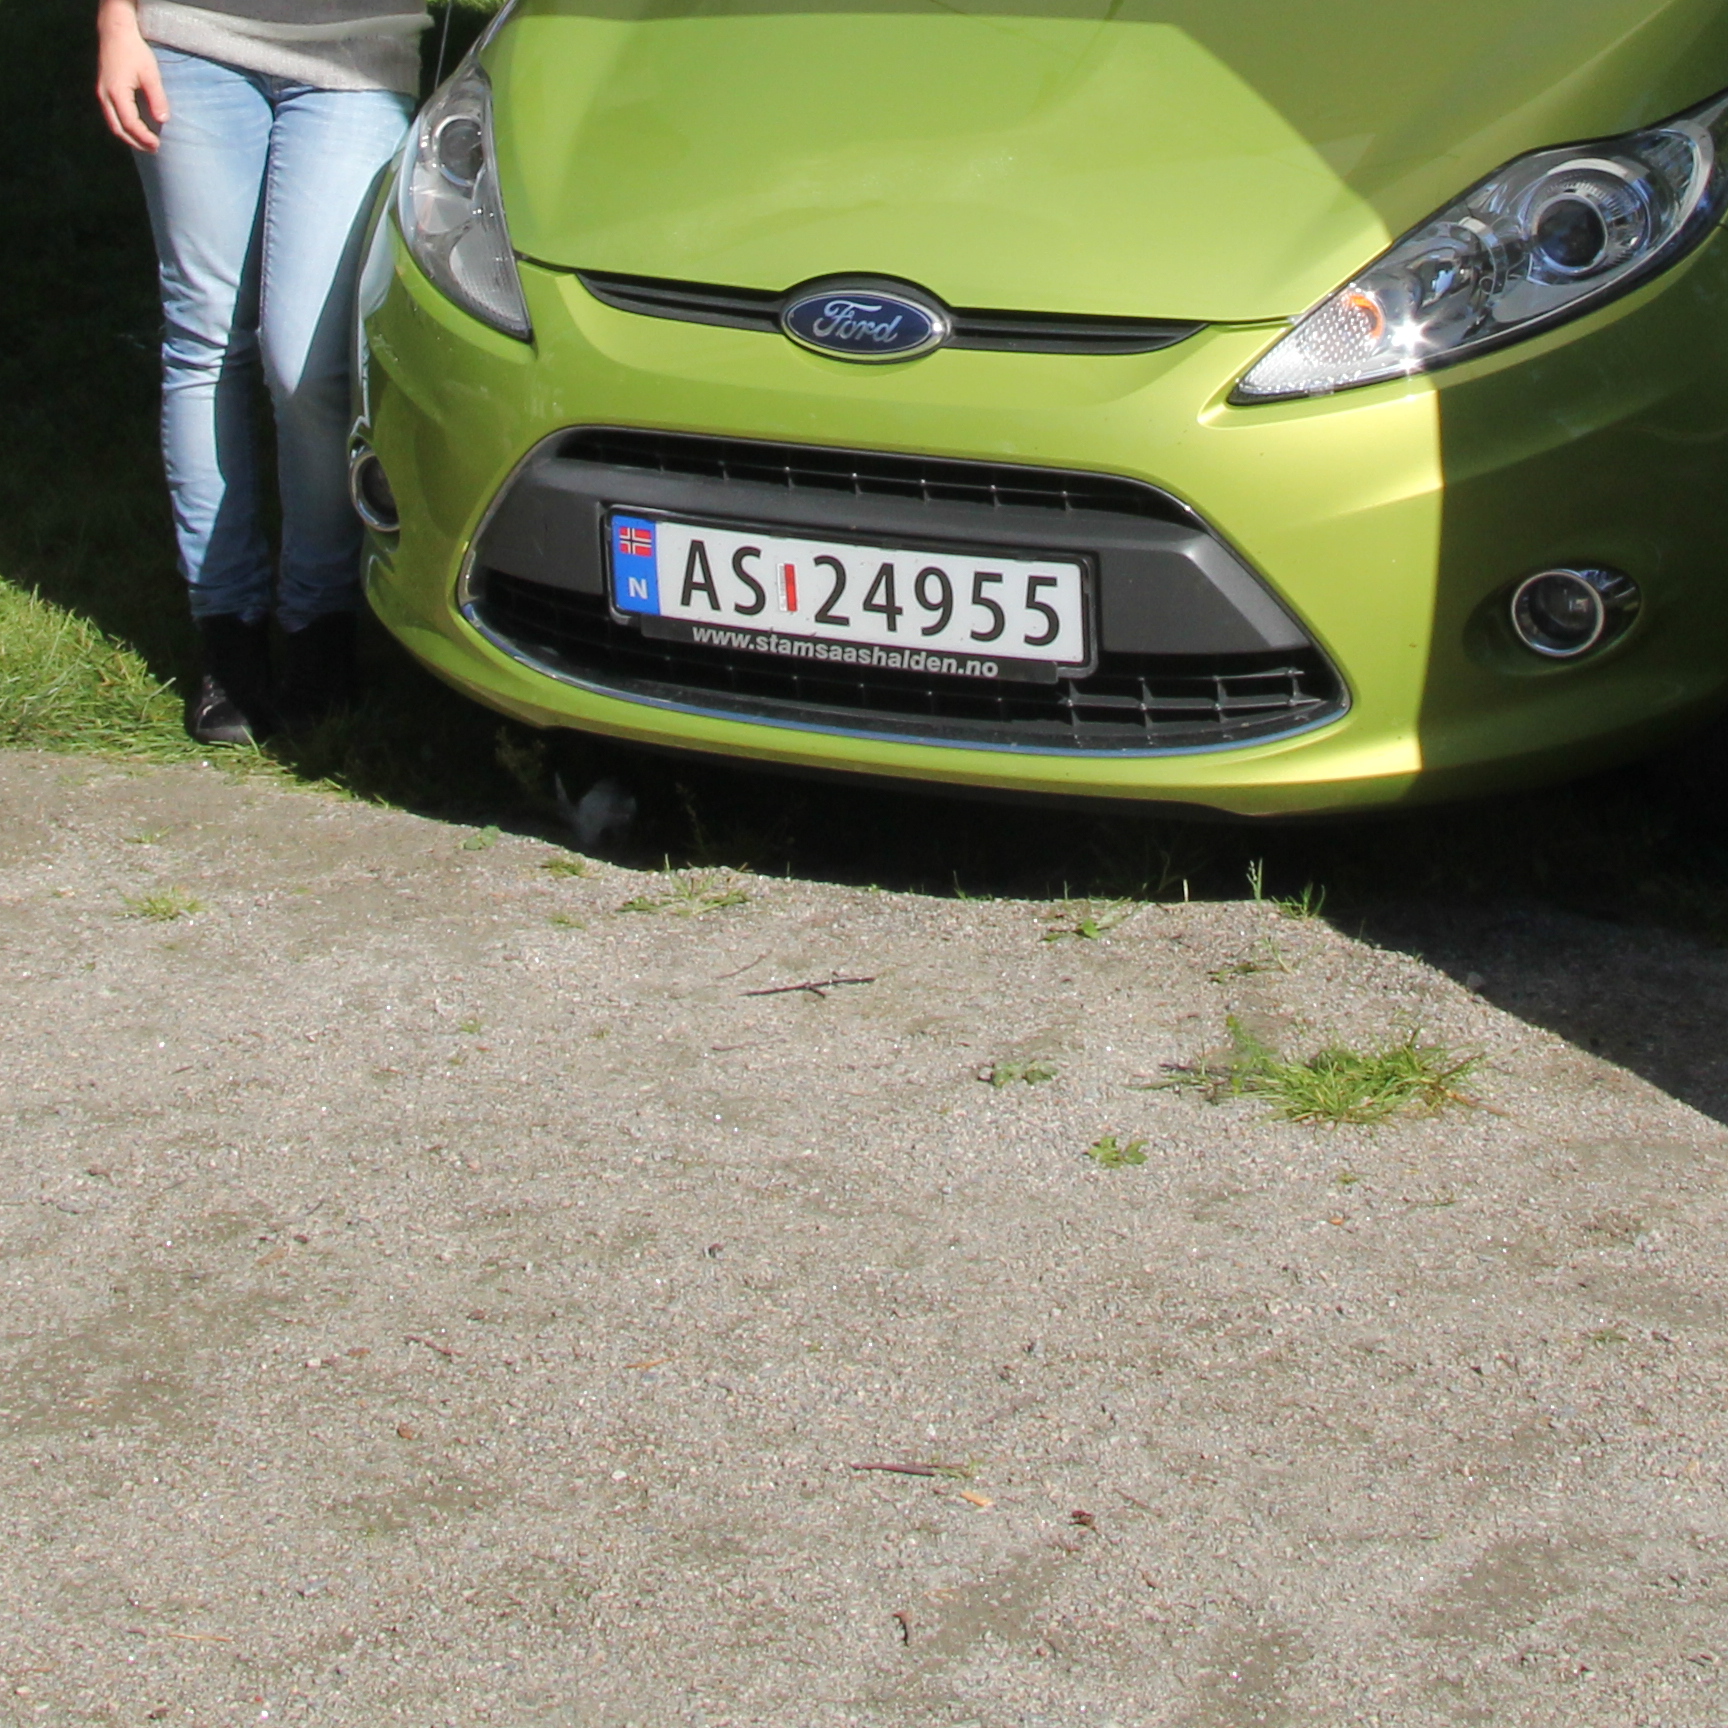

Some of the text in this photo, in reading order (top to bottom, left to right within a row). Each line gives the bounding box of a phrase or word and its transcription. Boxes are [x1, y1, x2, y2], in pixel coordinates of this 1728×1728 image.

[812, 300, 899, 344] Ford
[628, 576, 647, 600] N
[680, 539, 766, 616] AS
[813, 555, 1060, 646] 24955
[692, 626, 998, 678] www.stamsaashalden.no
